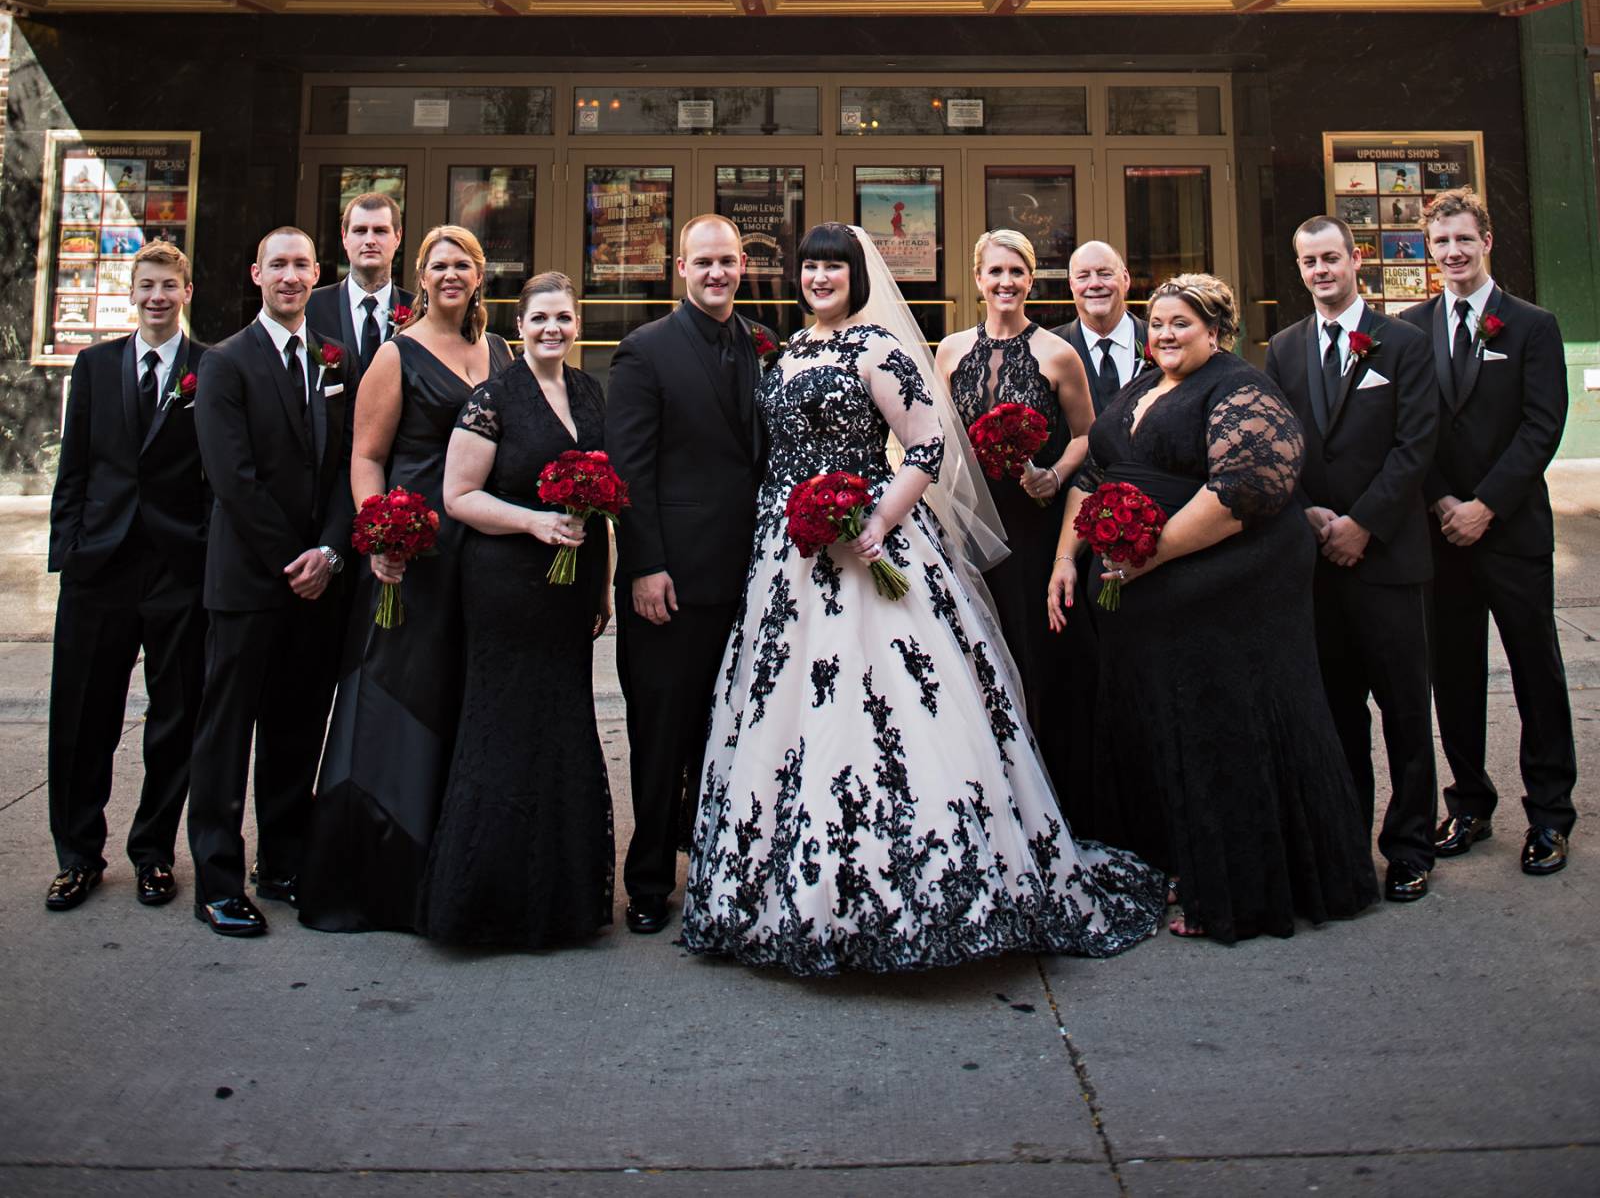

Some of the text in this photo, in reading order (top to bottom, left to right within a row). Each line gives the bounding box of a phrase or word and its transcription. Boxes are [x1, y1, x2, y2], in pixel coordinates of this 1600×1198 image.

[87, 146, 168, 155] UPCOMING SHOWS
[1357, 149, 1440, 159] UPCOMING SHOWS
[760, 203, 784, 212] LEWIS
[1384, 268, 1420, 277] FLOGGING
[1385, 277, 1407, 286] MOLLY
